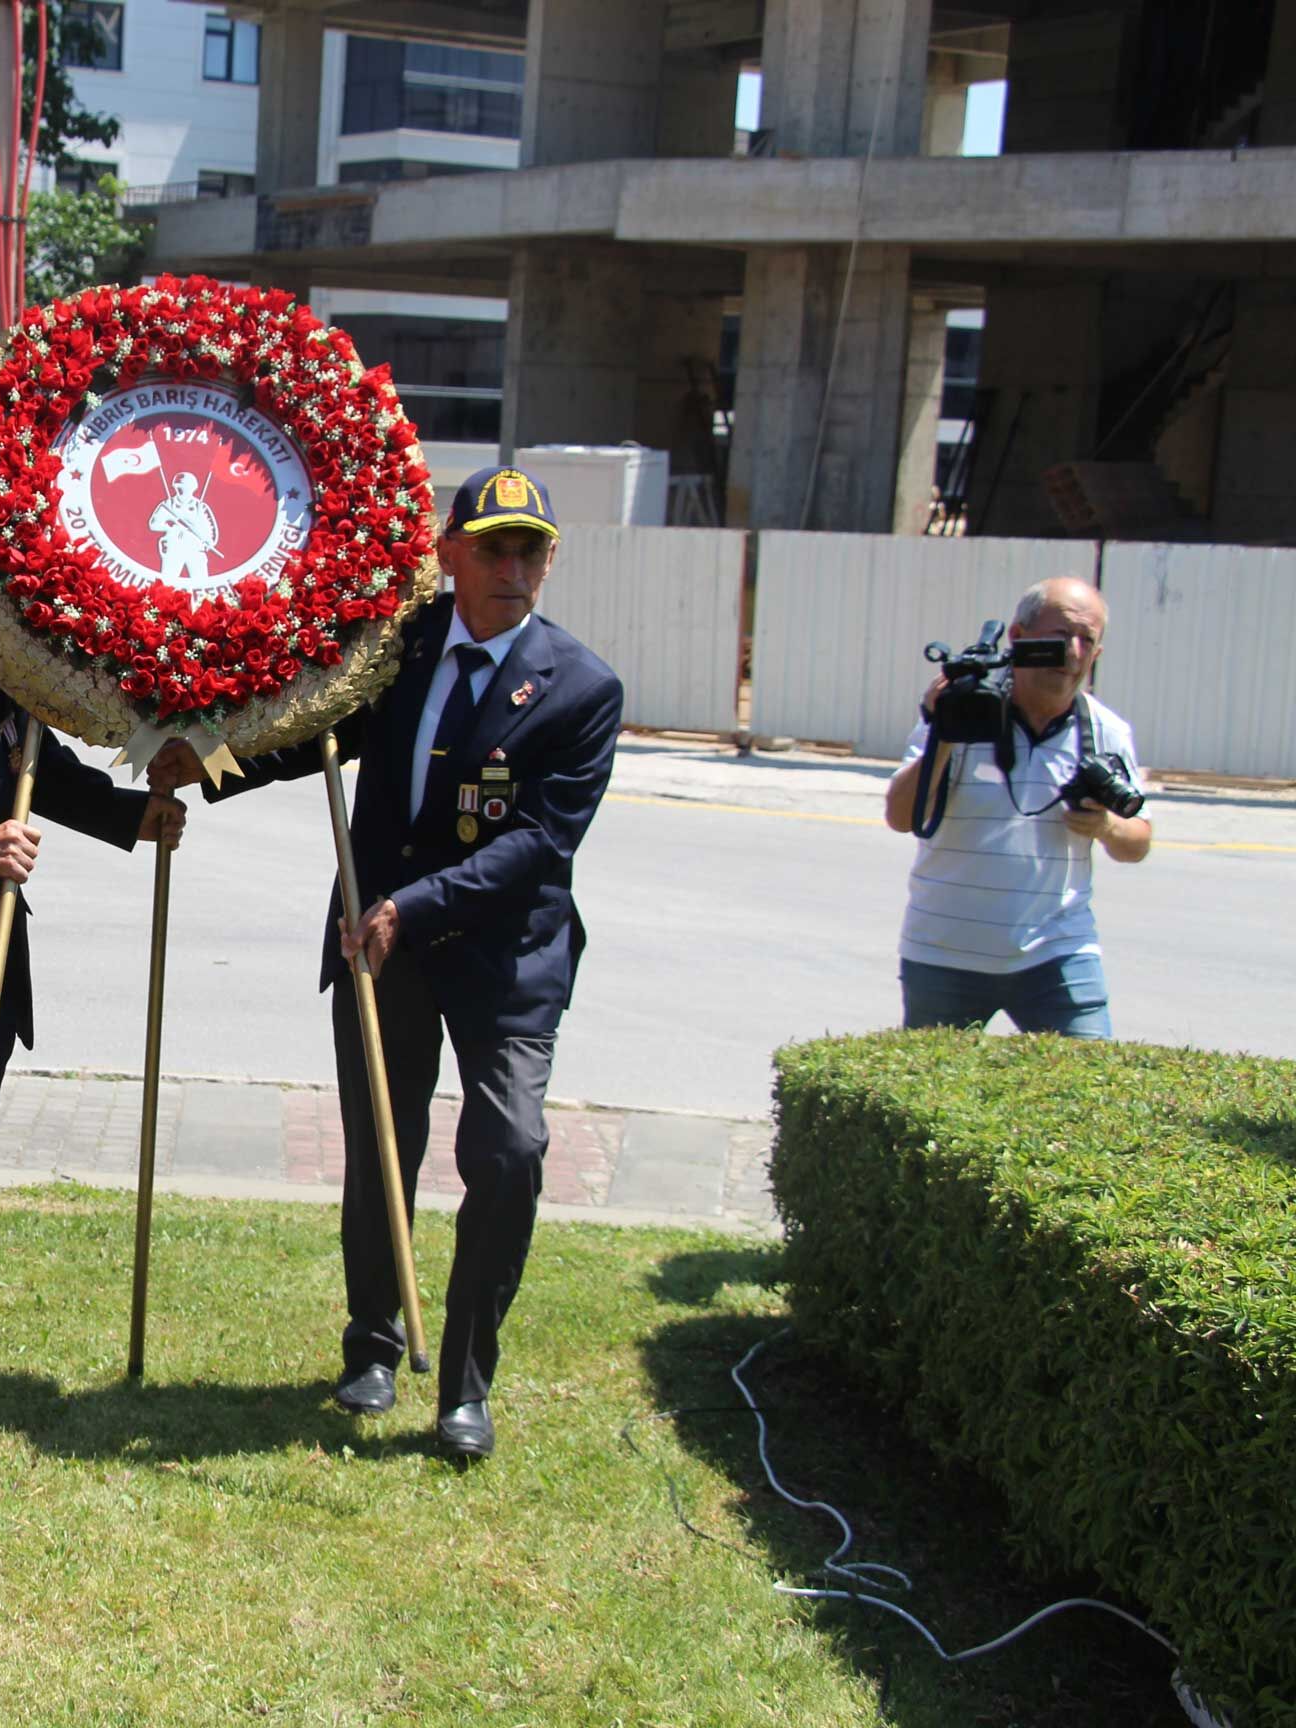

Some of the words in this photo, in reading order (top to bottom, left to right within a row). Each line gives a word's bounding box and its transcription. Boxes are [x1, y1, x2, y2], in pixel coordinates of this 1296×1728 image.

[78, 398, 135, 445] KIBRIS
[137, 388, 198, 410] BARIŞ
[203, 393, 292, 464] HAREKATI
[163, 426, 209, 445] 1974
[65, 506, 87, 530] 20
[88, 530, 154, 588] TMMU
[244, 523, 303, 581] ERNEĞİ
